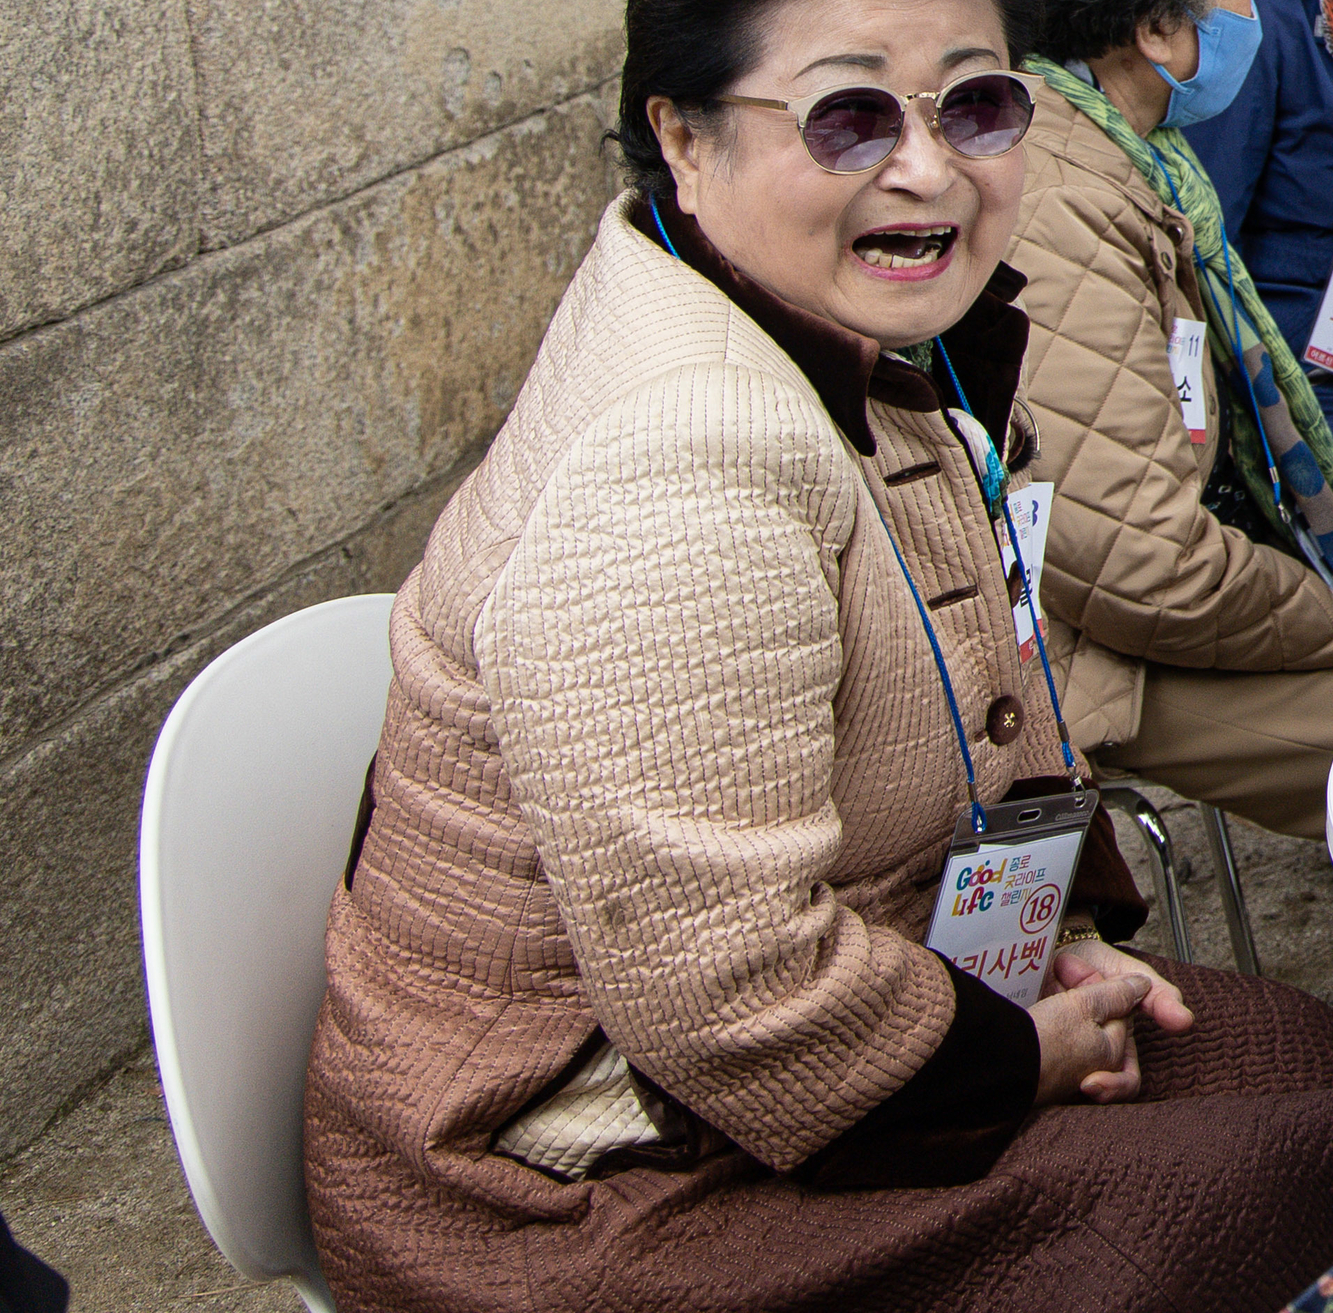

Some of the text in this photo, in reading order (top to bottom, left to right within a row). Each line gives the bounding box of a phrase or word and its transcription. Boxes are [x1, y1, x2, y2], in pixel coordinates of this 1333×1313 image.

[1188, 334, 1200, 357] 11
[957, 858, 1008, 891] Good
[1009, 855, 1031, 872] 종로
[1004, 868, 1046, 890] 굿라이프
[1001, 887, 1032, 907] 챌린지
[950, 936, 1048, 979] 리사벳
